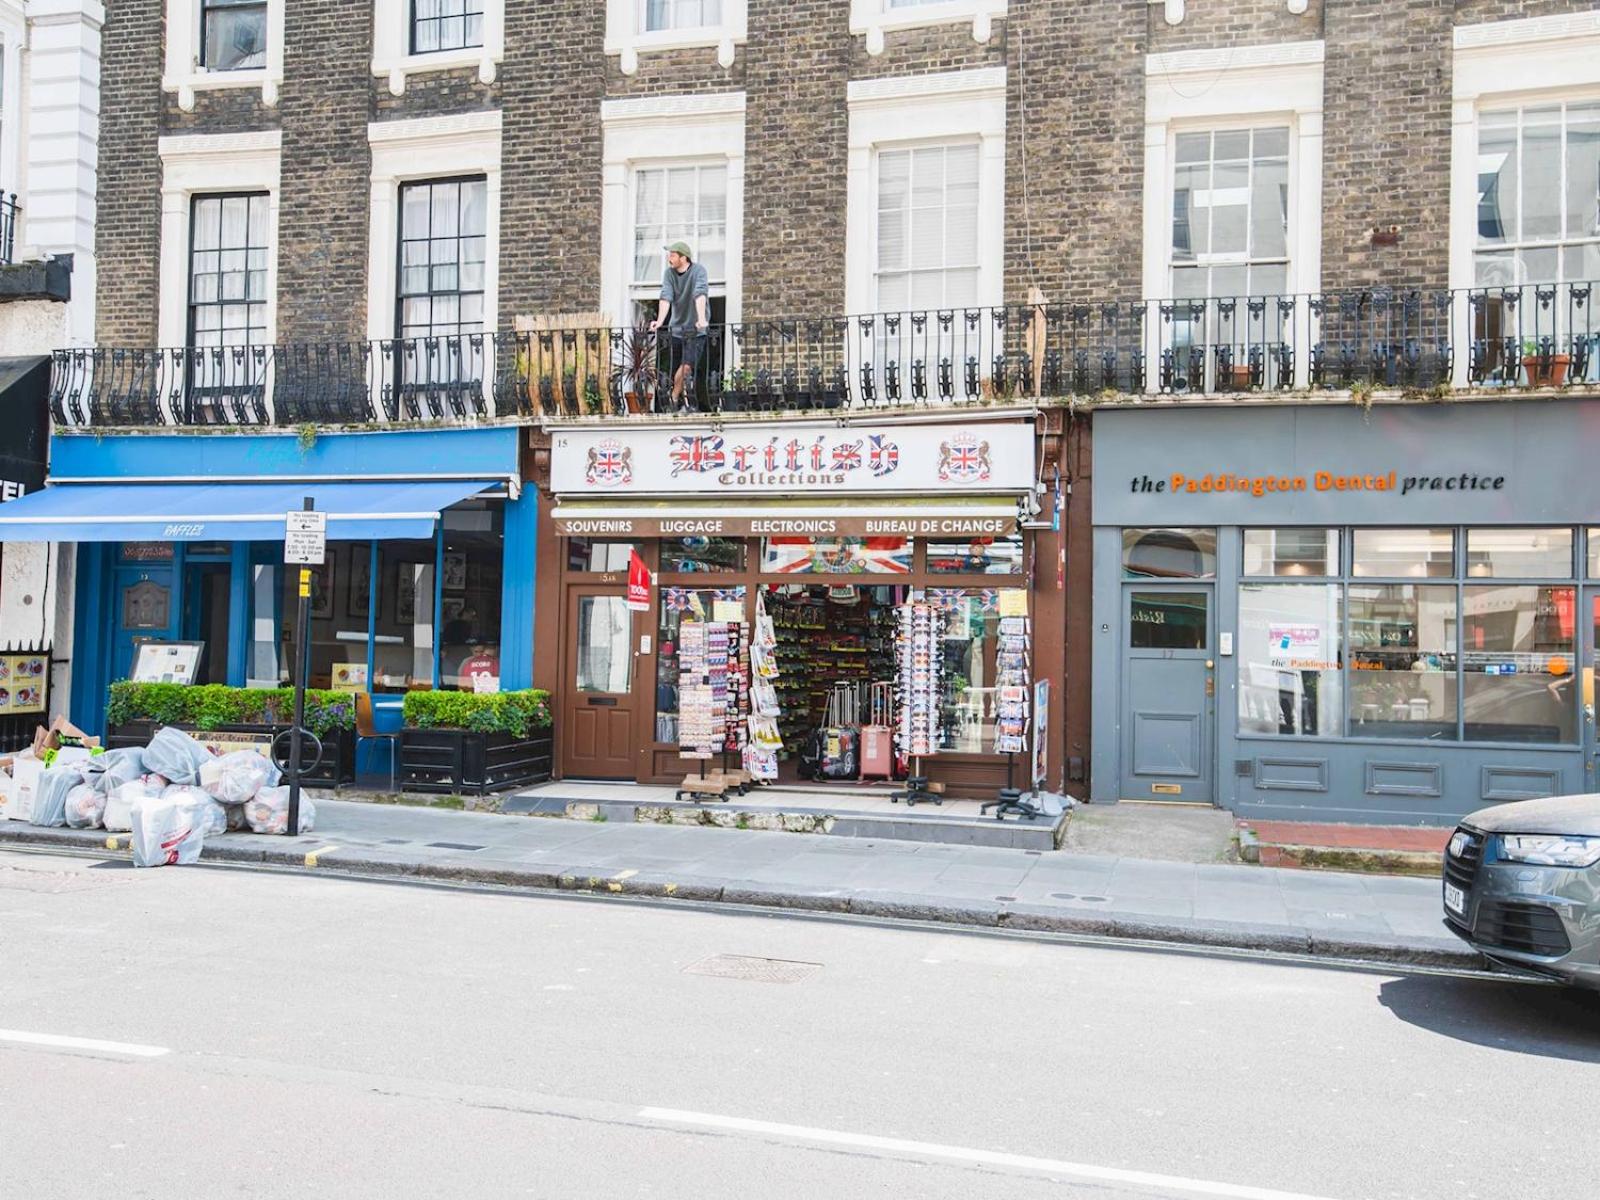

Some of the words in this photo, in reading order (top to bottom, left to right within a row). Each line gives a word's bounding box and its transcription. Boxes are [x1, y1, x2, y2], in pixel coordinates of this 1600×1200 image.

[558, 439, 568, 448] 15
[669, 433, 899, 478] British
[718, 472, 845, 486] Collections
[1130, 475, 1166, 493] the
[1170, 473, 1307, 497] Paddington
[1314, 470, 1397, 492] Dental
[1402, 473, 1505, 496] practice
[565, 520, 632, 533] SOUVENIRS
[660, 520, 722, 533] LUGGAGE
[751, 520, 836, 533] ELECTRONICS
[865, 519, 917, 533] BUREAU
[925, 519, 938, 532] DE
[942, 519, 1003, 532] CHANGE
[1271, 658, 1286, 667] the
[1290, 659, 1344, 670] Paddington
